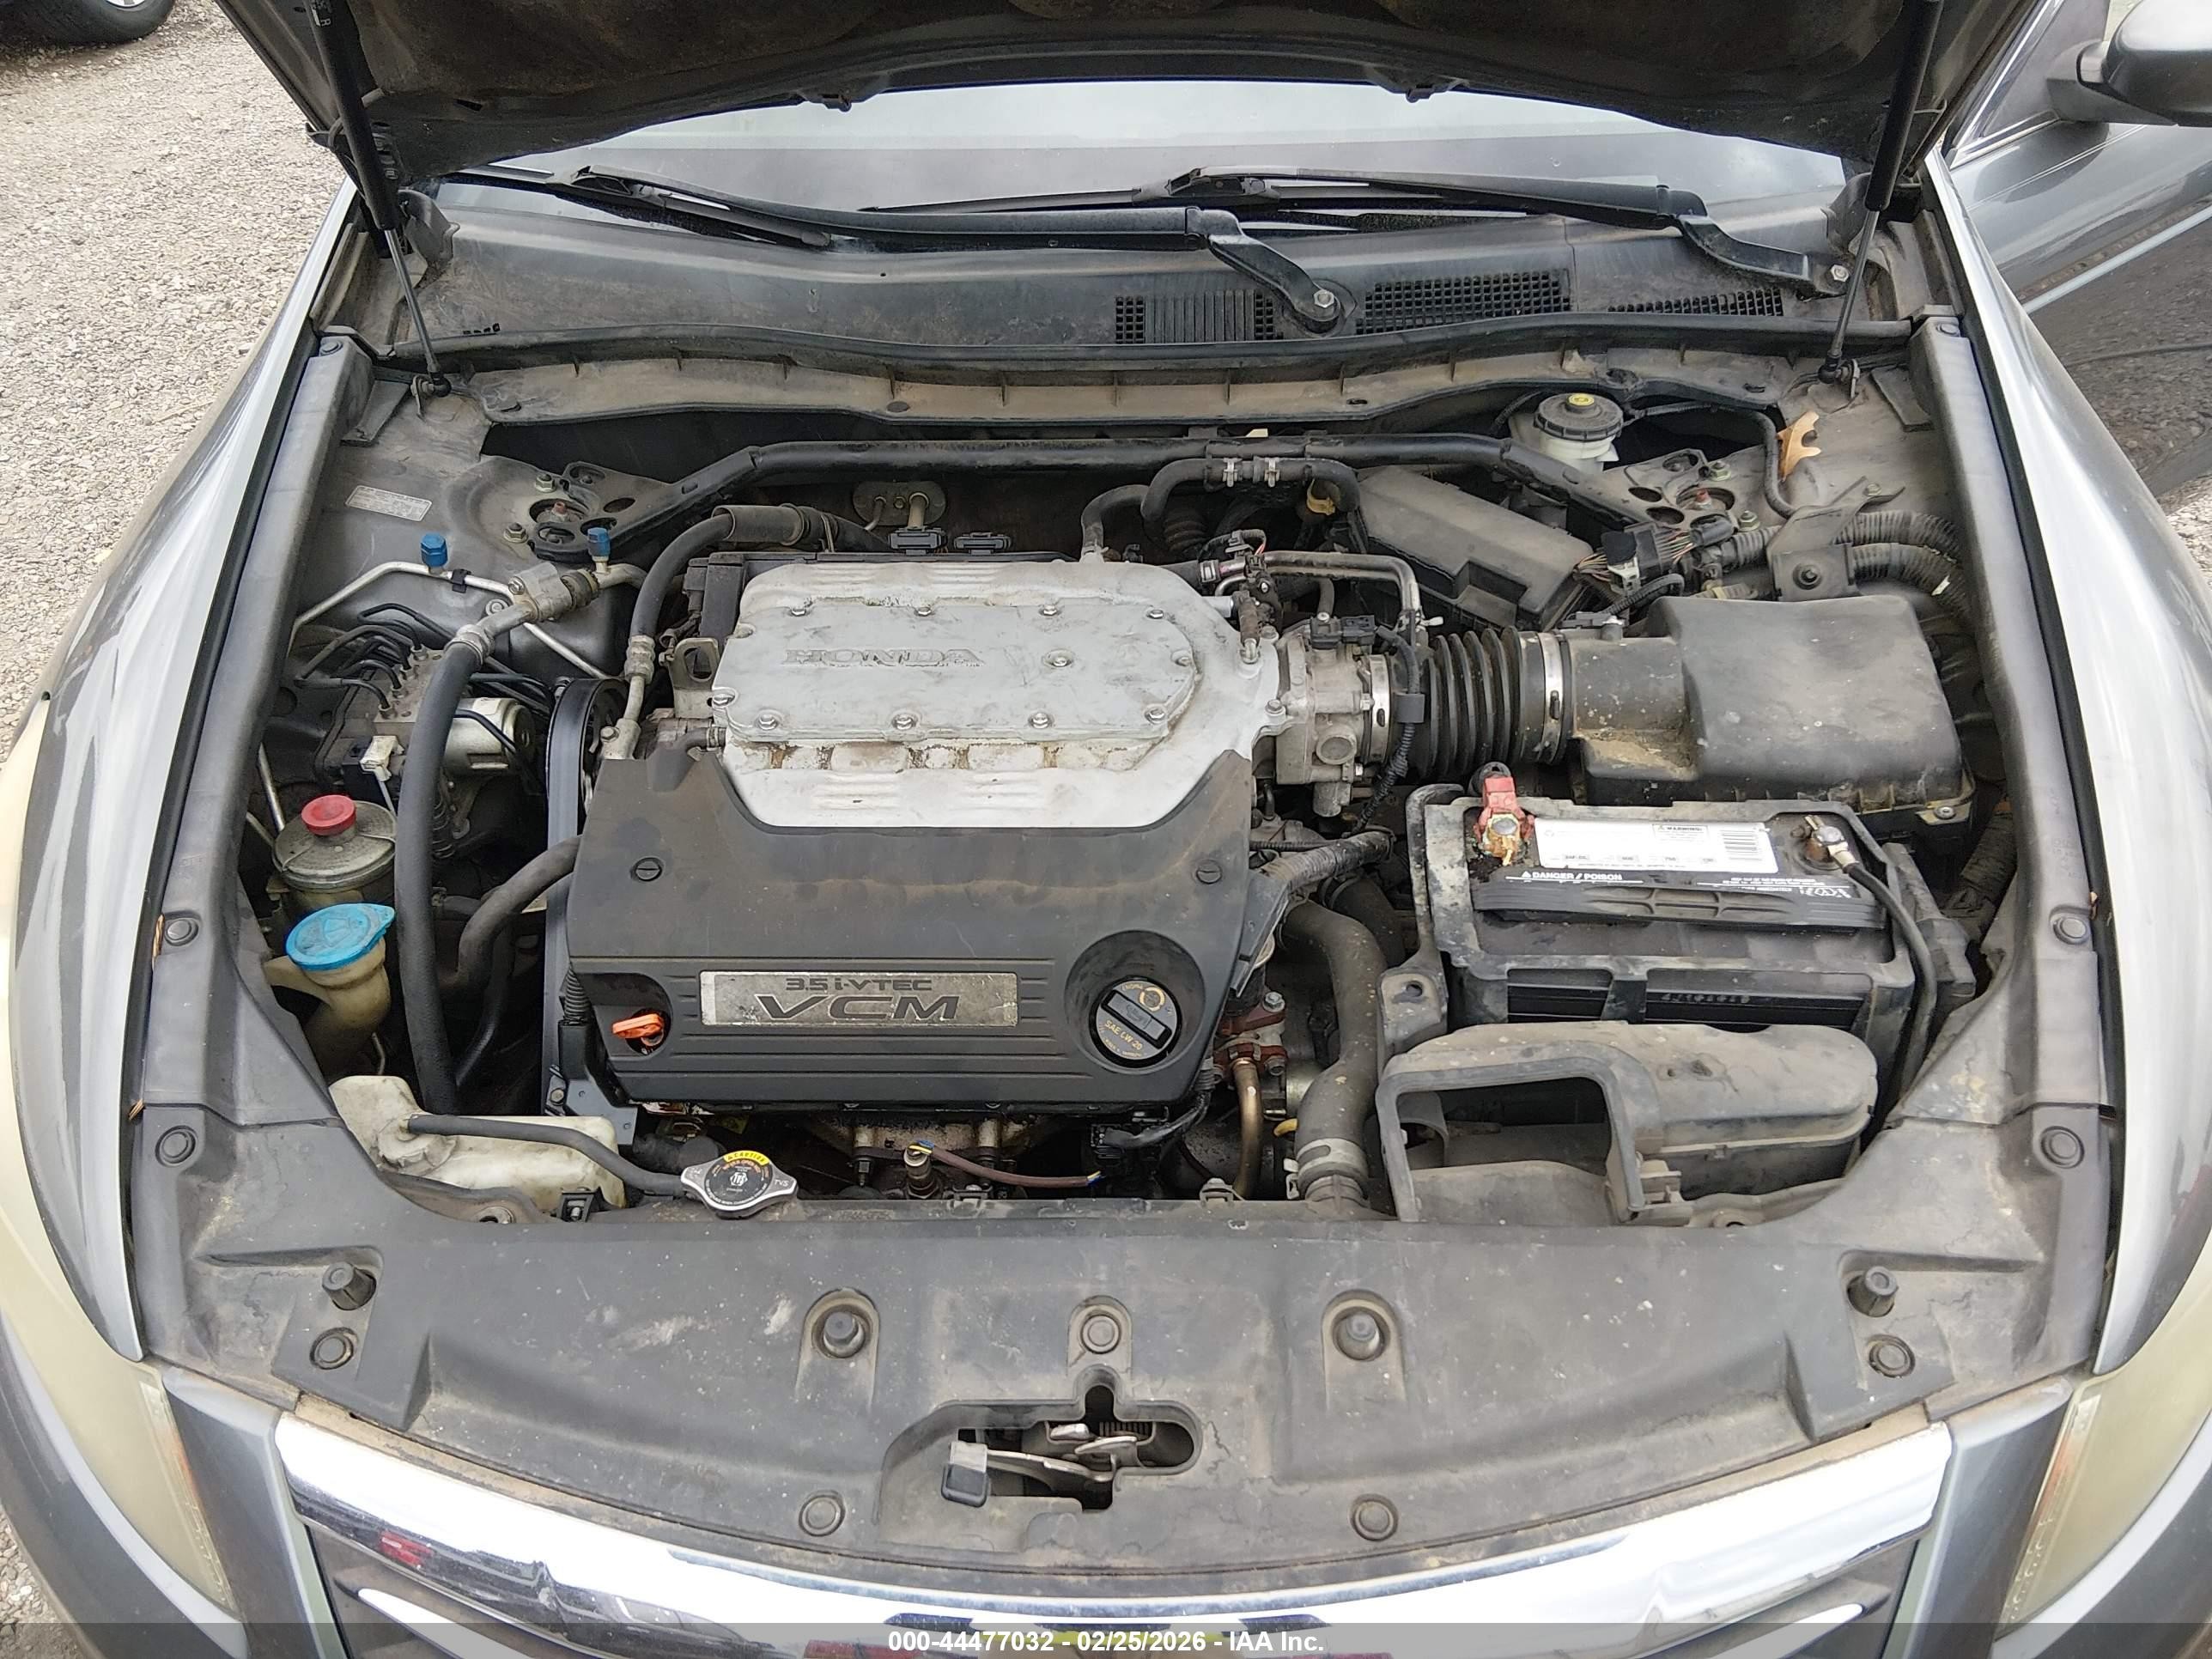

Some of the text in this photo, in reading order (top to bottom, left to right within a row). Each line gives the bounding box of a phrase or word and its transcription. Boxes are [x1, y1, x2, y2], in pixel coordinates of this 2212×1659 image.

[781, 648, 986, 667] HONDA
[1583, 872, 1623, 881] POISON
[835, 978, 933, 991] i-VTEC
[755, 994, 961, 1020] VCM
[1105, 1020, 1121, 1036] SAE
[774, 1179, 789, 1188] TVS
